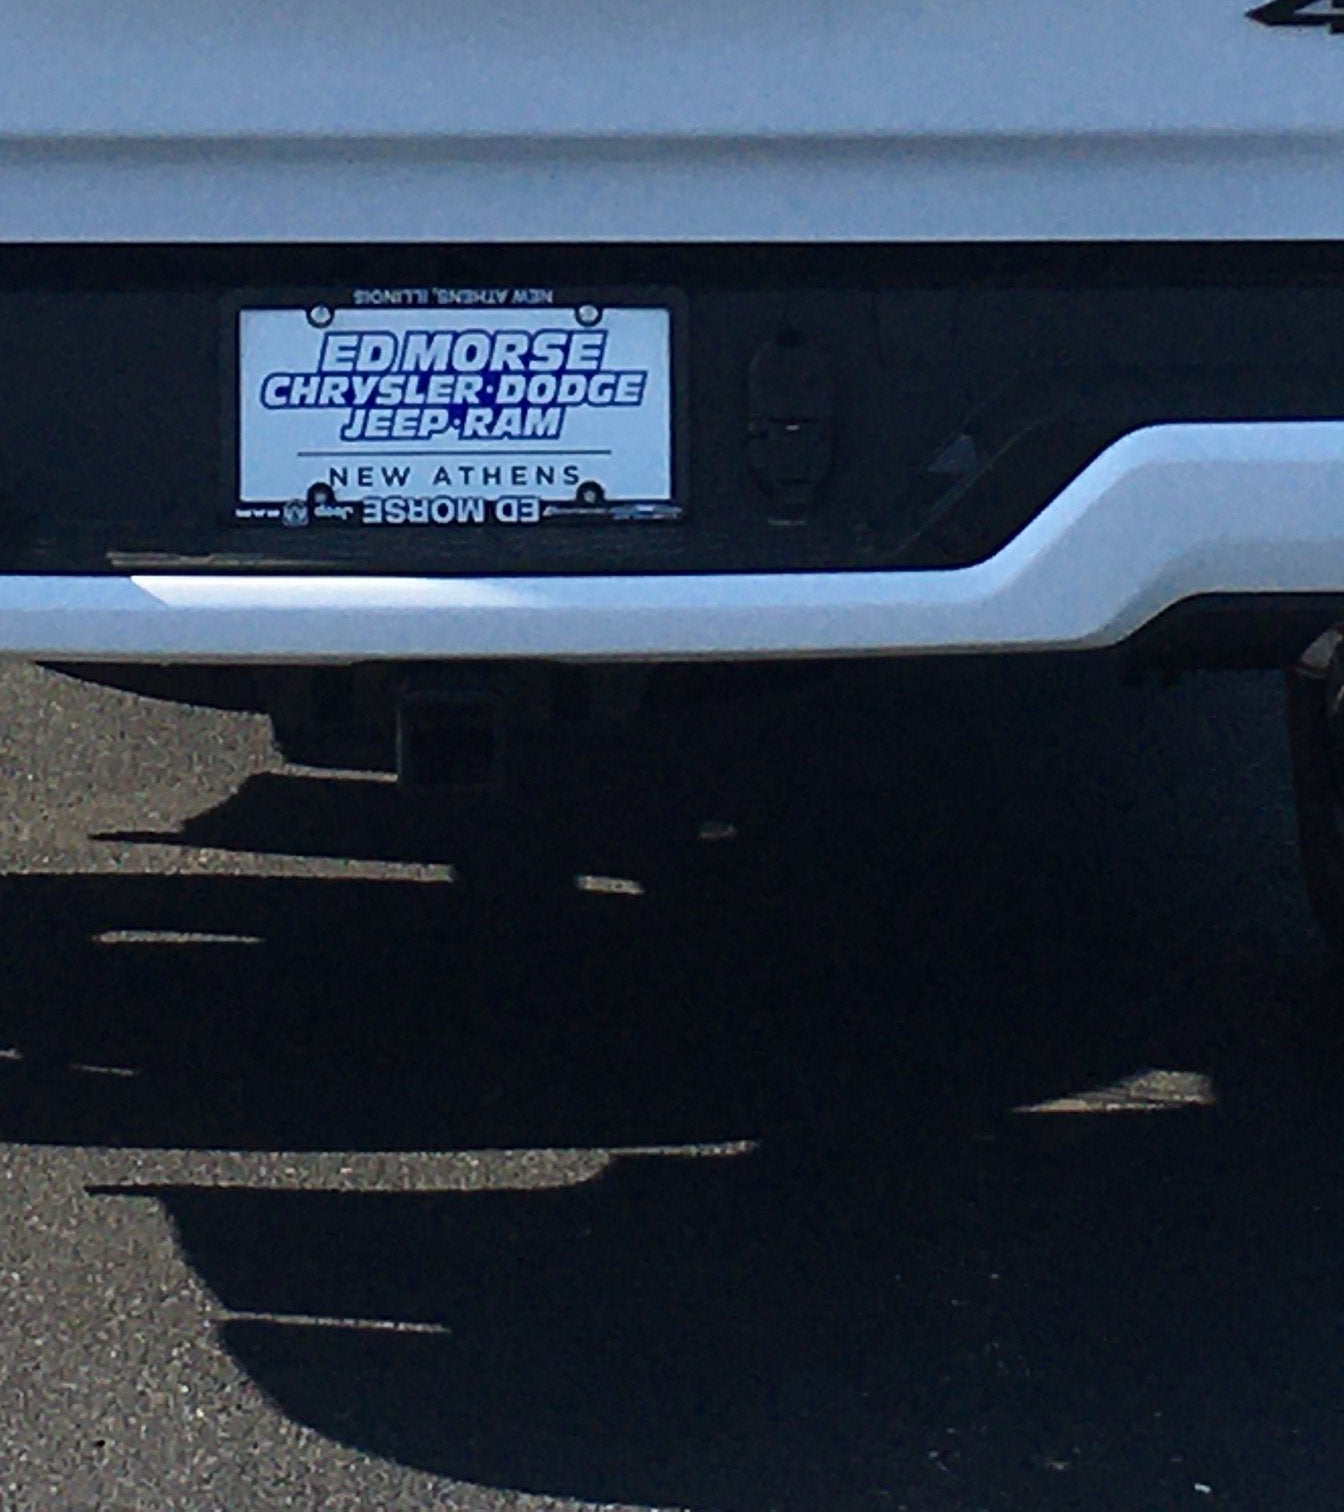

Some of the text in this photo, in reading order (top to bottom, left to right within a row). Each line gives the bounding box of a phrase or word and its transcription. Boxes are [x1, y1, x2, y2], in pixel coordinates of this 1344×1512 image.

[353, 288, 429, 304] ILLINOIS
[511, 288, 554, 304] NEW
[317, 329, 607, 373] ED MORSE
[329, 465, 581, 486] NEW ATHENS
[361, 496, 485, 524] MORSE
[494, 497, 540, 523] ED
